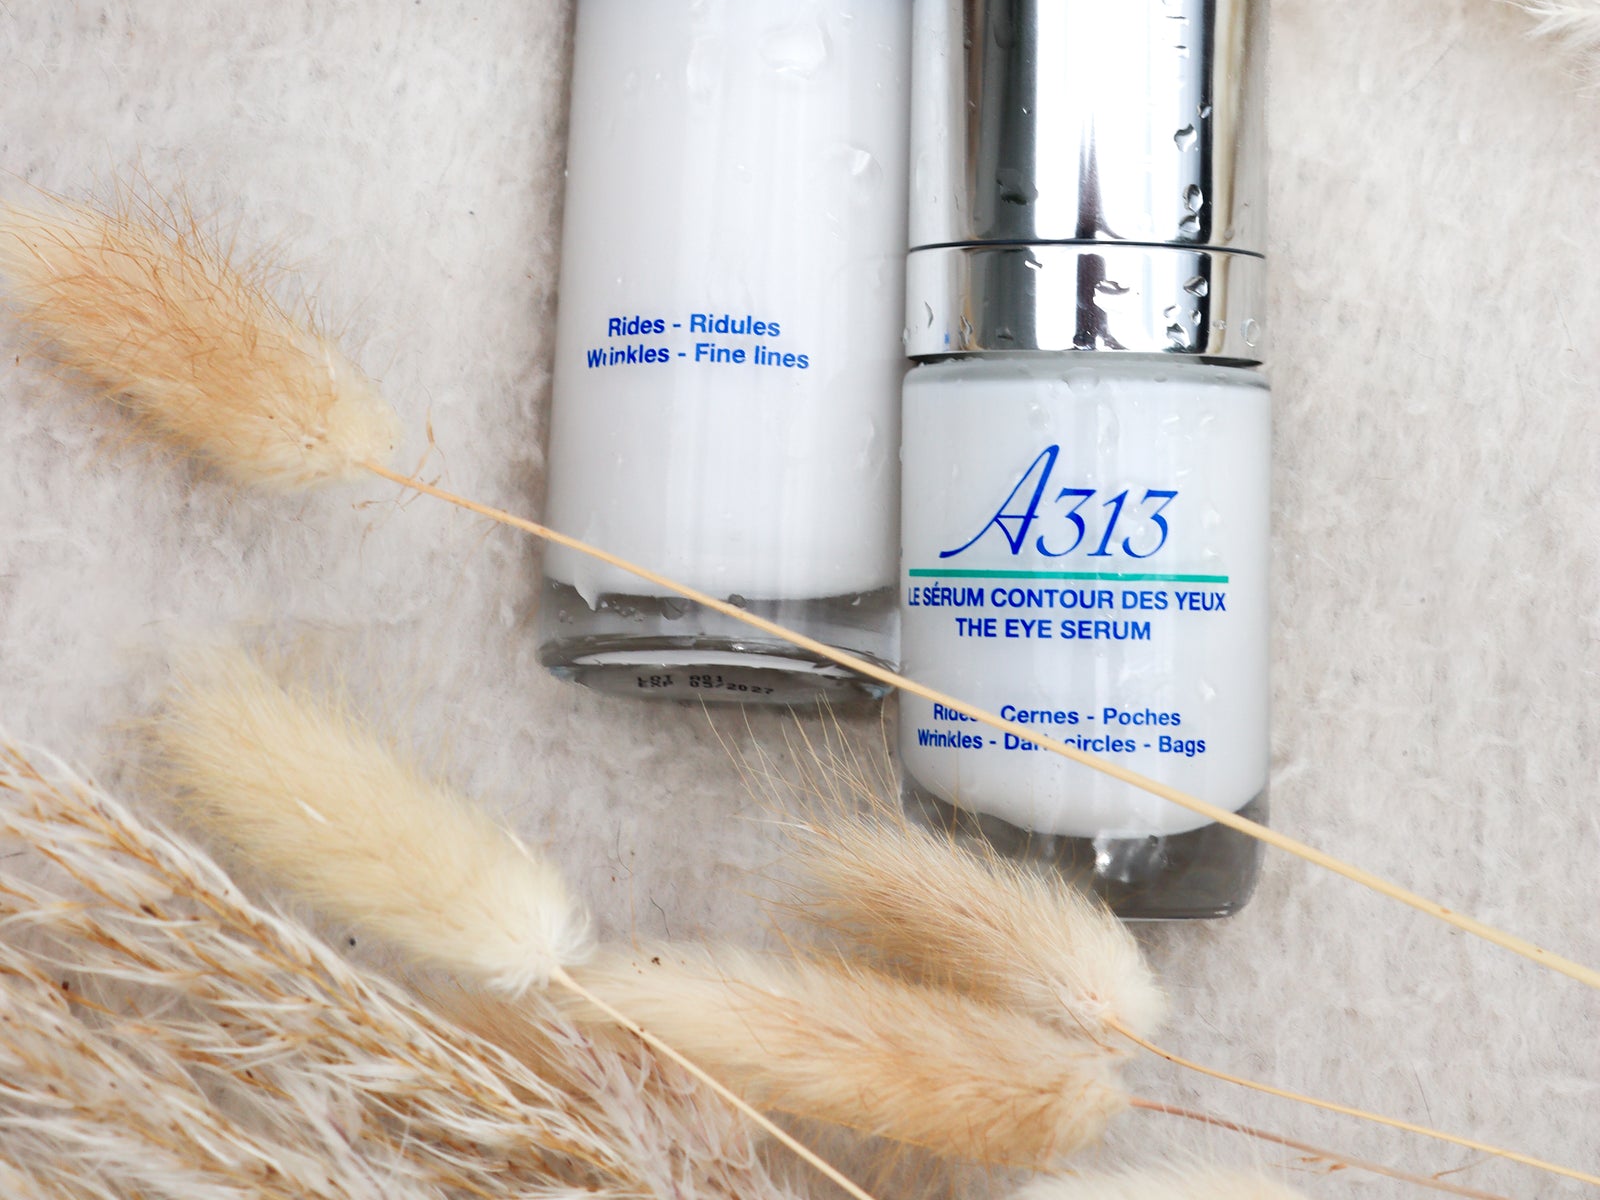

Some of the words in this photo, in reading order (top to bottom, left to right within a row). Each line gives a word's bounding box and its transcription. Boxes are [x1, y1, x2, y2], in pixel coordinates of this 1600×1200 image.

[607, 314, 666, 337] Rides
[689, 312, 781, 338] Ridules
[694, 342, 747, 365] Fine
[753, 344, 810, 370] lines
[938, 443, 1180, 560] A313
[908, 586, 920, 607] LE
[922, 581, 985, 608] SÉRUM
[990, 586, 1115, 611] CONTOUR
[1121, 588, 1169, 612] DES
[1174, 590, 1227, 612] YEUX
[954, 616, 998, 639] THE
[1004, 617, 1053, 640] EYE
[1059, 618, 1152, 641] SERUM
[933, 703, 978, 723] Ride
[999, 704, 1081, 726] Cernes
[1102, 706, 1182, 727] Poches
[917, 728, 984, 750] Wrinkles
[1003, 732, 1047, 752] Dar
[1157, 734, 1207, 758] Bags
